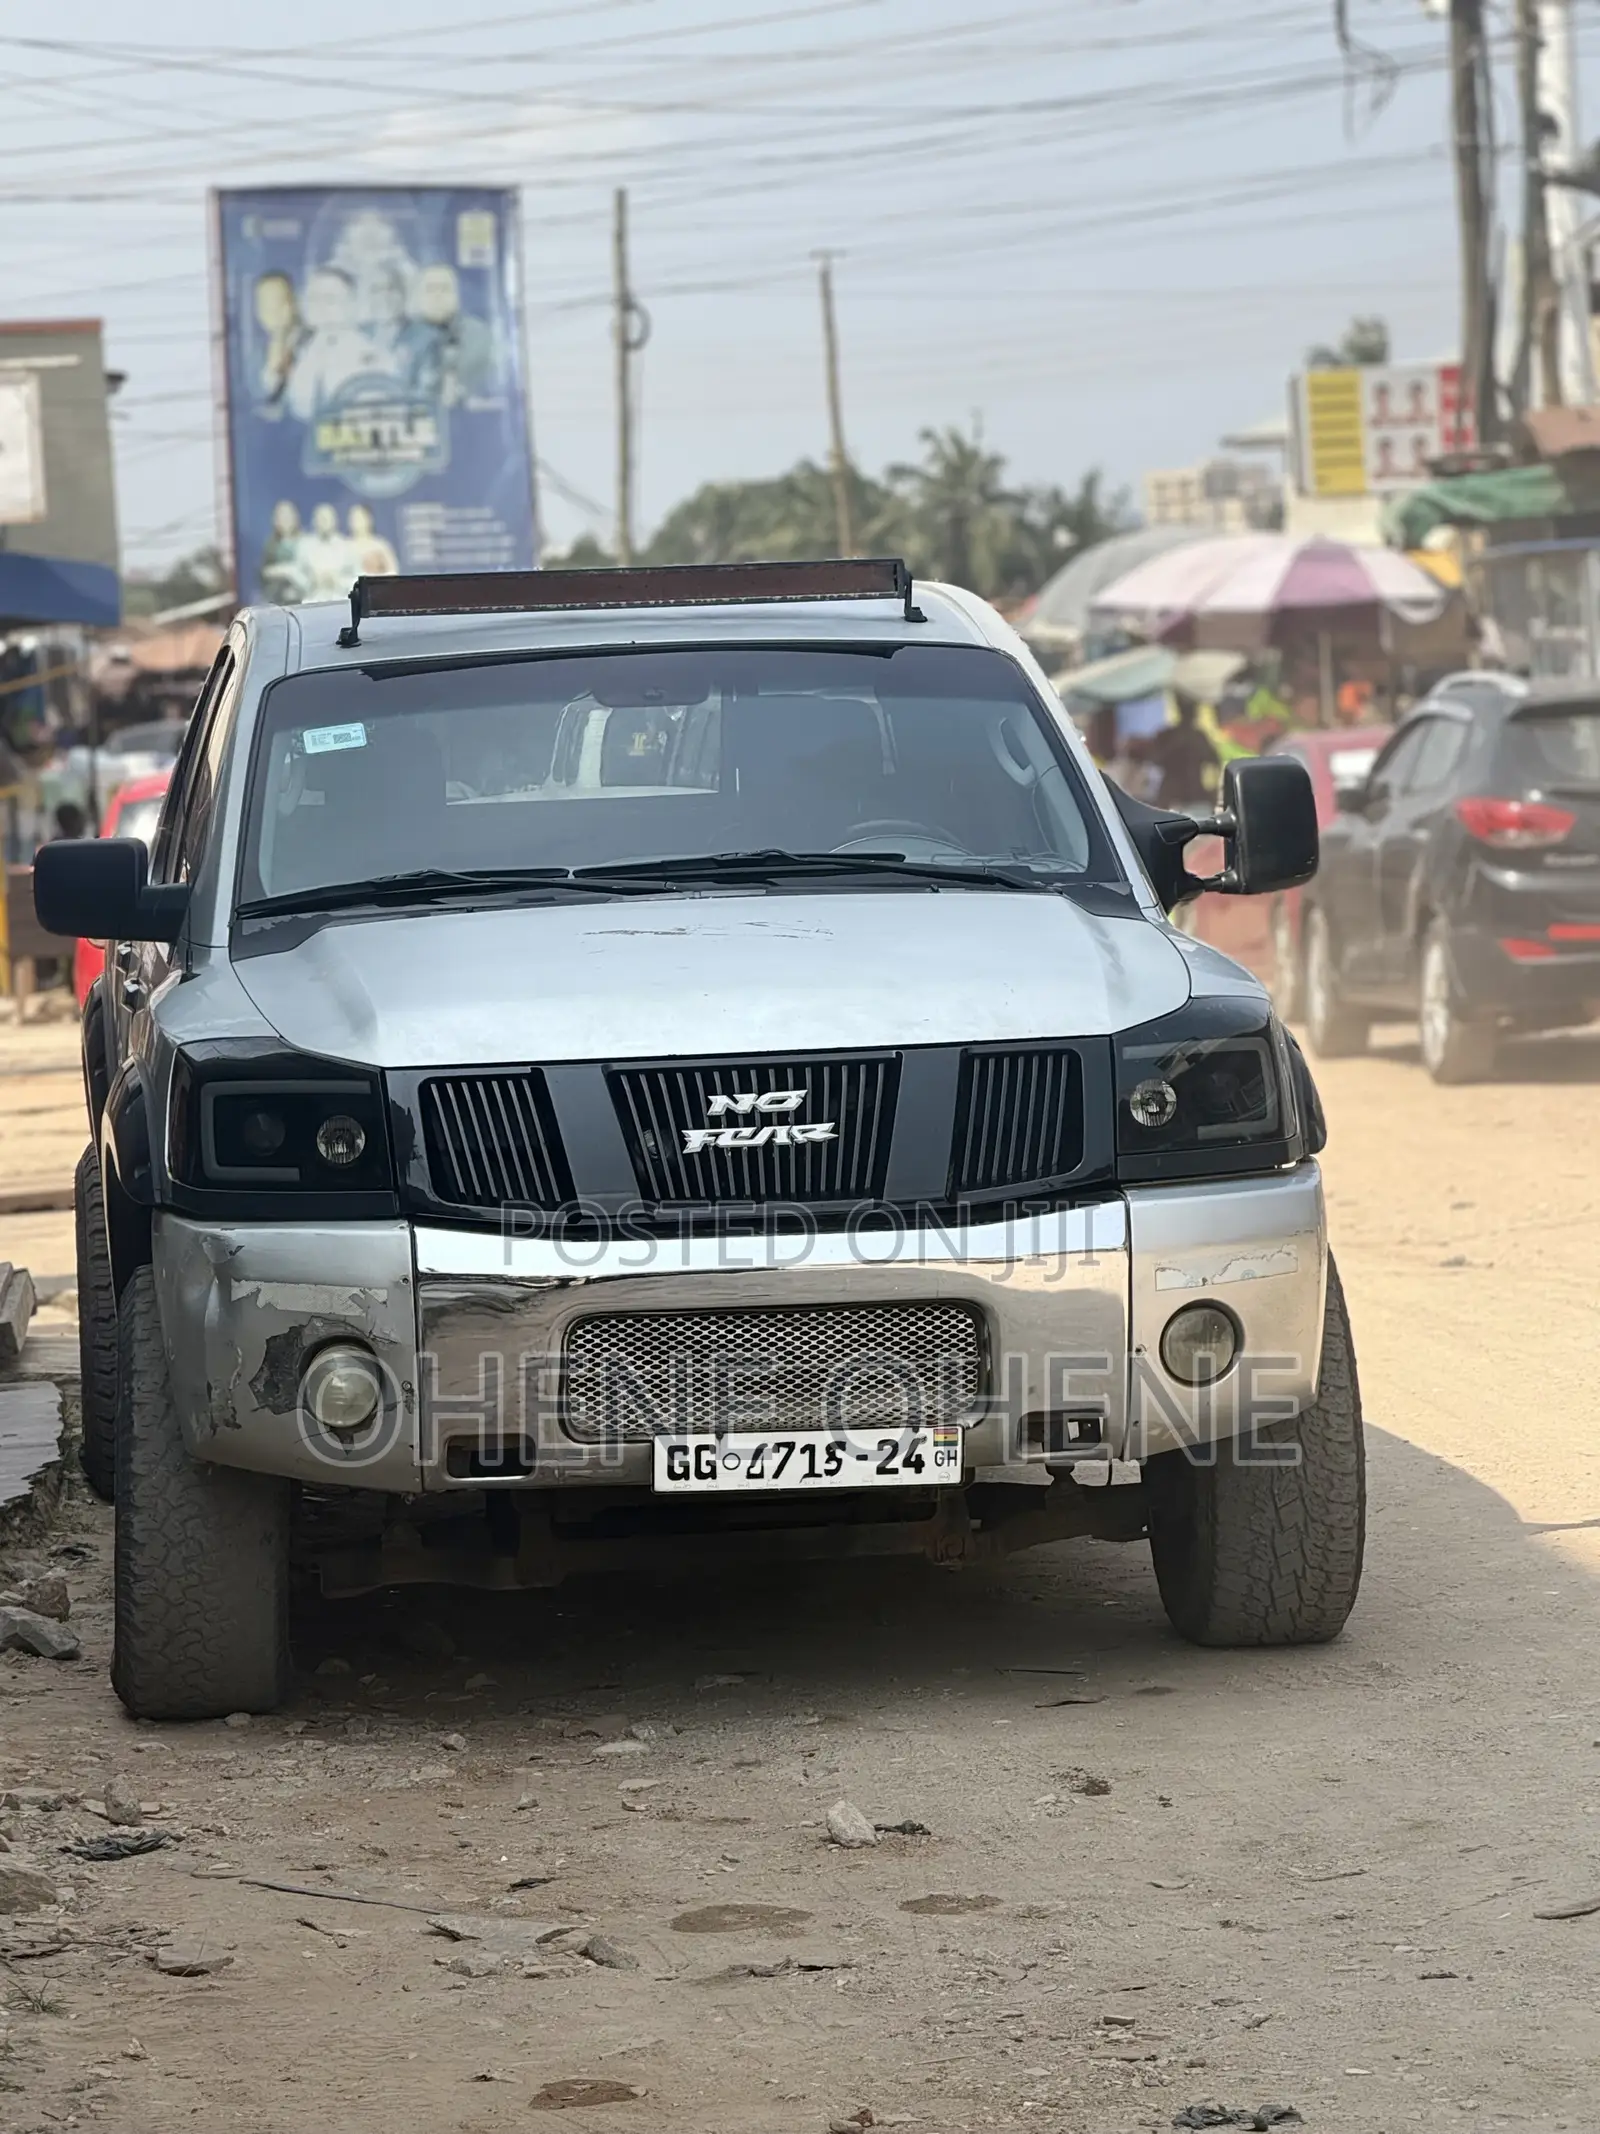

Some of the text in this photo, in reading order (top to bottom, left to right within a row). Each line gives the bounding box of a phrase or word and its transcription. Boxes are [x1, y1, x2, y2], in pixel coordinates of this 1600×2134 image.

[706, 1089, 808, 1117] NO
[666, 1443, 718, 1481] GG
[934, 1450, 958, 1467] GH
